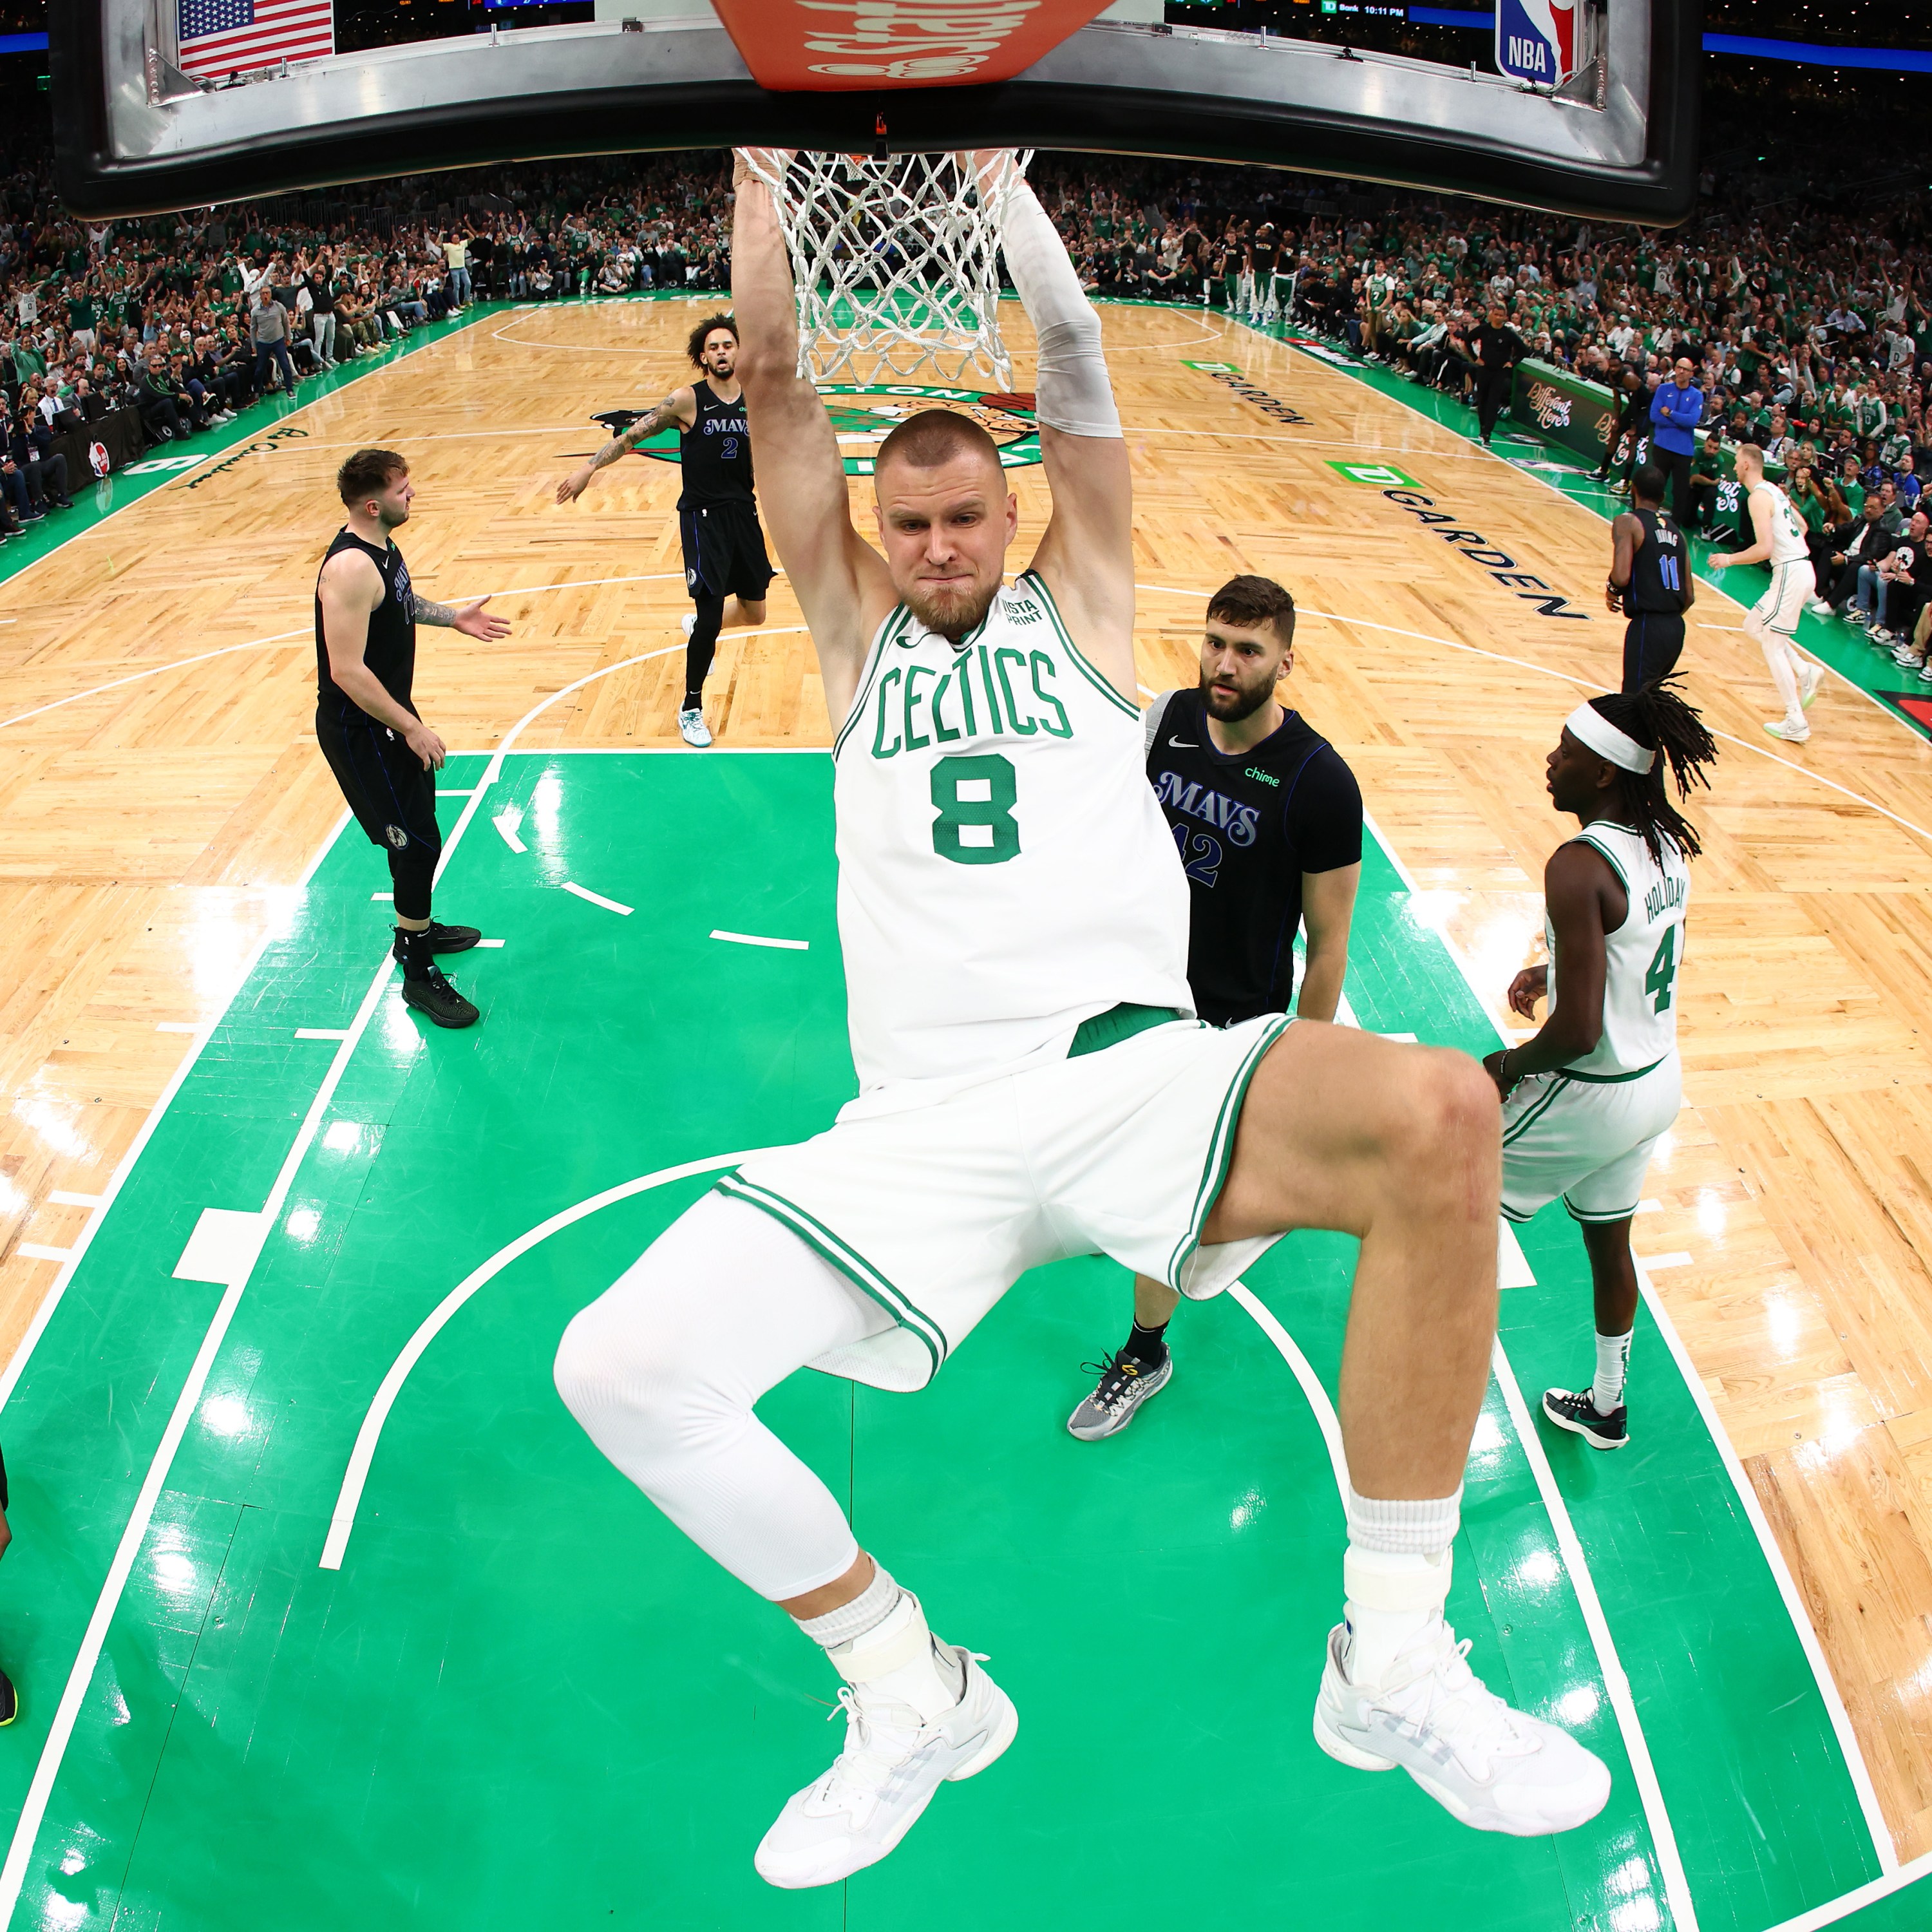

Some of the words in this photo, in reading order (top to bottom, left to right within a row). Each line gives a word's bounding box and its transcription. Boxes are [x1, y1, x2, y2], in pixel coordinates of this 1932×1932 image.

[1323, 1, 1336, 11] TD
[1339, 3, 1359, 12] Bank
[1365, 6, 1387, 15] 10:11
[1389, 8, 1404, 17] PM
[795, 0, 1043, 56] Stat
[1508, 35, 1546, 73] NBA
[513, 296, 656, 310] BOSTON
[1373, 291, 1379, 301] 7
[1191, 362, 1233, 372] TD
[816, 385, 972, 398] STON
[1209, 372, 1315, 426] GARDEN
[1526, 381, 1573, 416] Different
[721, 437, 738, 459] 2
[1345, 466, 1405, 486] TD
[1380, 488, 1595, 621] GARDEN
[1654, 529, 1678, 547] IRVING
[1659, 554, 1680, 591] 11
[1006, 610, 1044, 626] PRINT
[871, 645, 1074, 759] CELTICS
[1245, 767, 1280, 787] chime
[930, 753, 1023, 865] 8
[1153, 770, 1261, 847] MAVS
[1644, 876, 1686, 925] HOLIDAY
[1645, 923, 1676, 1016] 4
